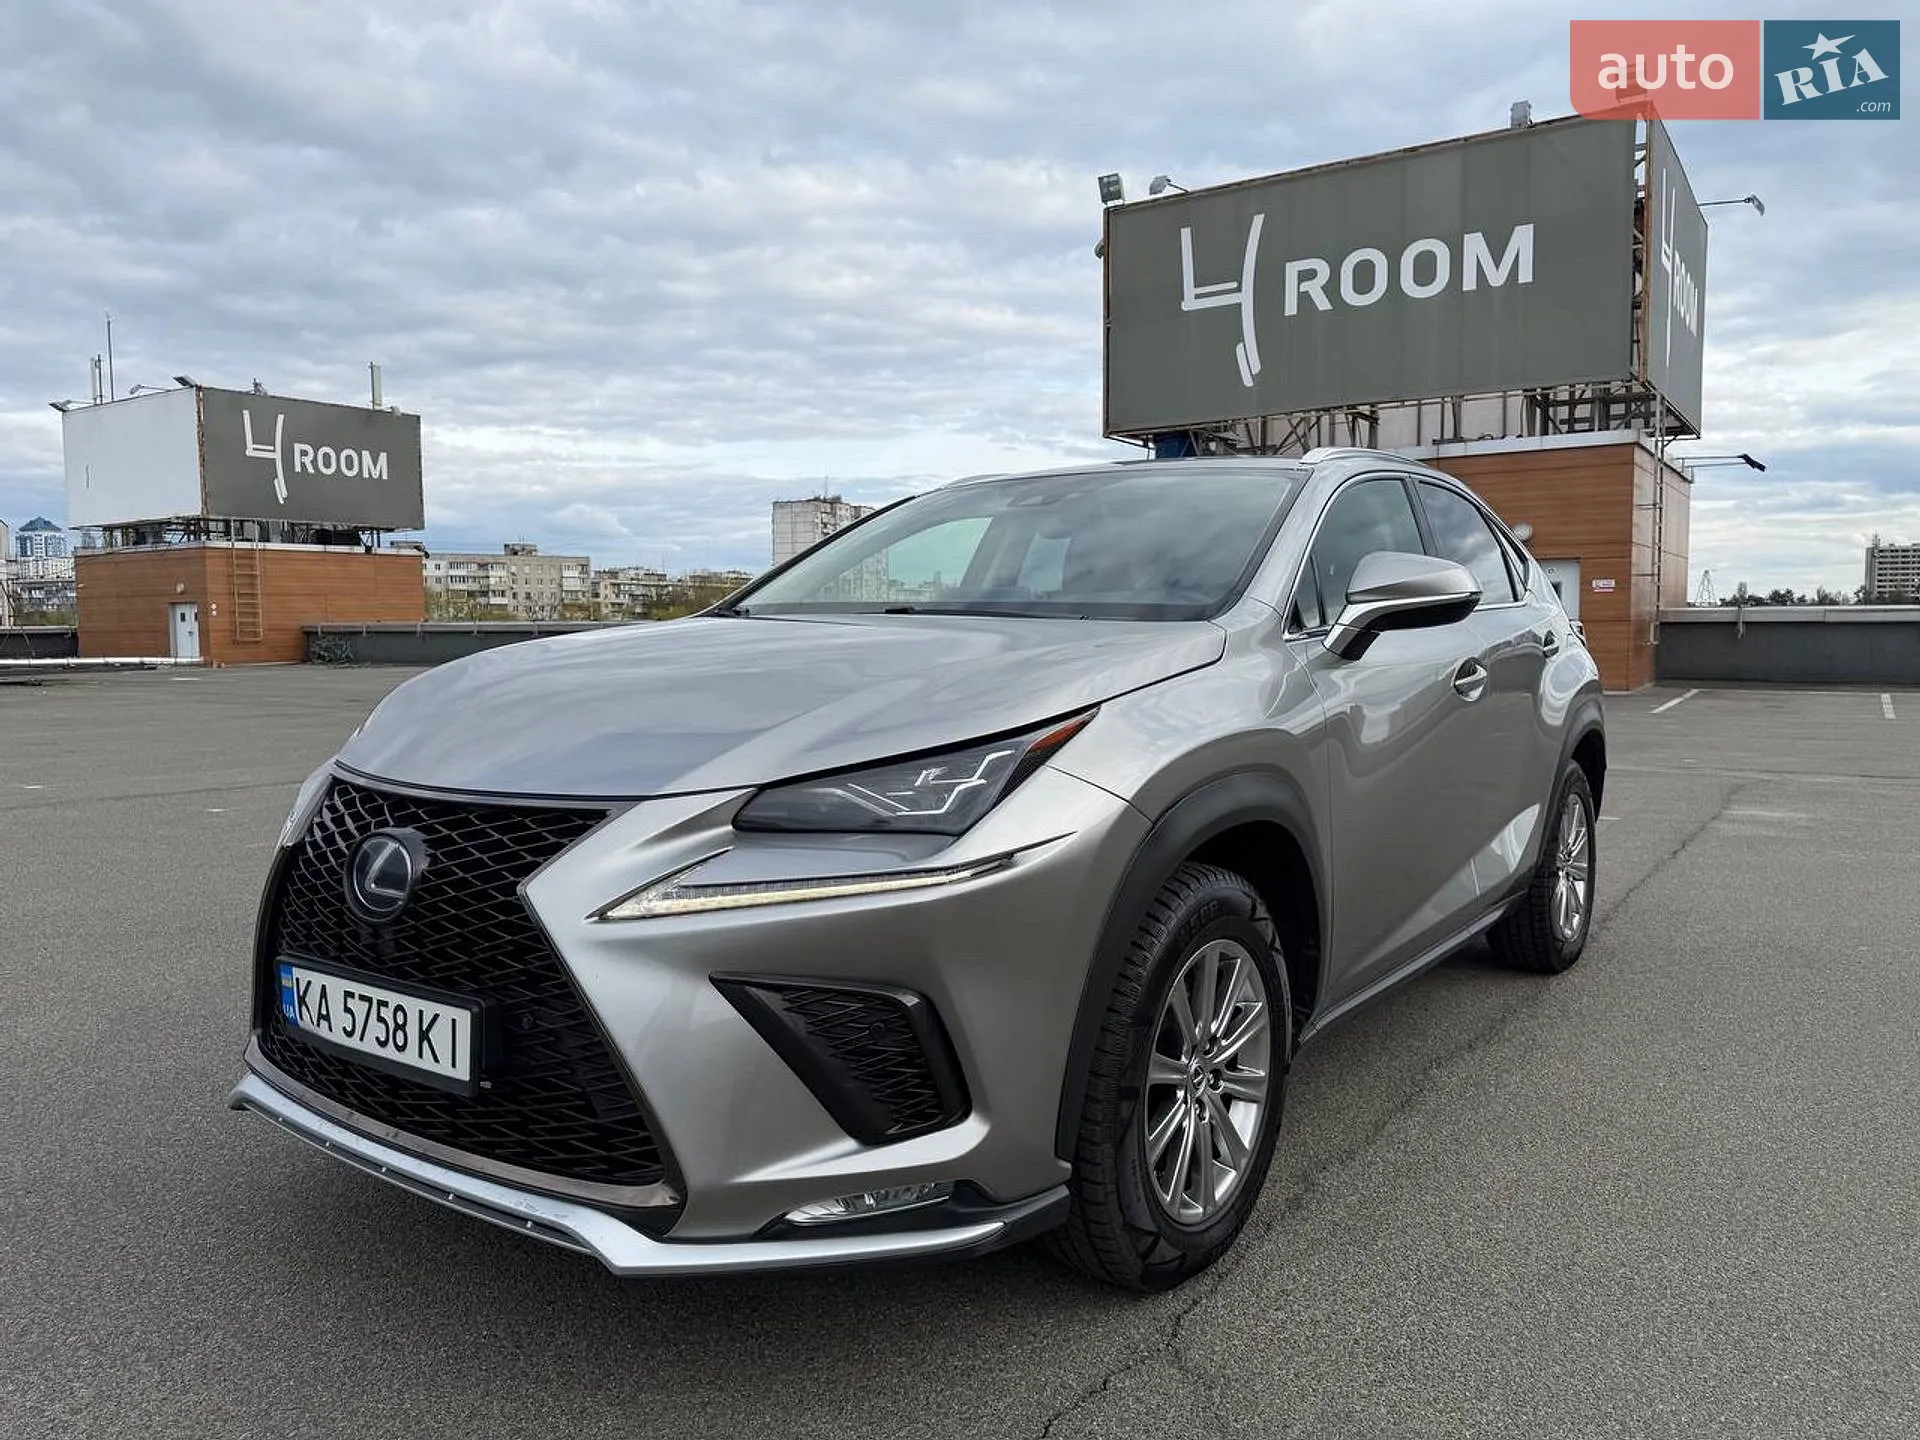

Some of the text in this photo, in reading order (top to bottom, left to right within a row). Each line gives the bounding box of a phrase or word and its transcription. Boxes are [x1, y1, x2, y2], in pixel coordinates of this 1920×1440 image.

[1284, 223, 1534, 317] ROOM
[294, 442, 389, 480] ROOM
[295, 976, 457, 1069] KA 5758 KI
